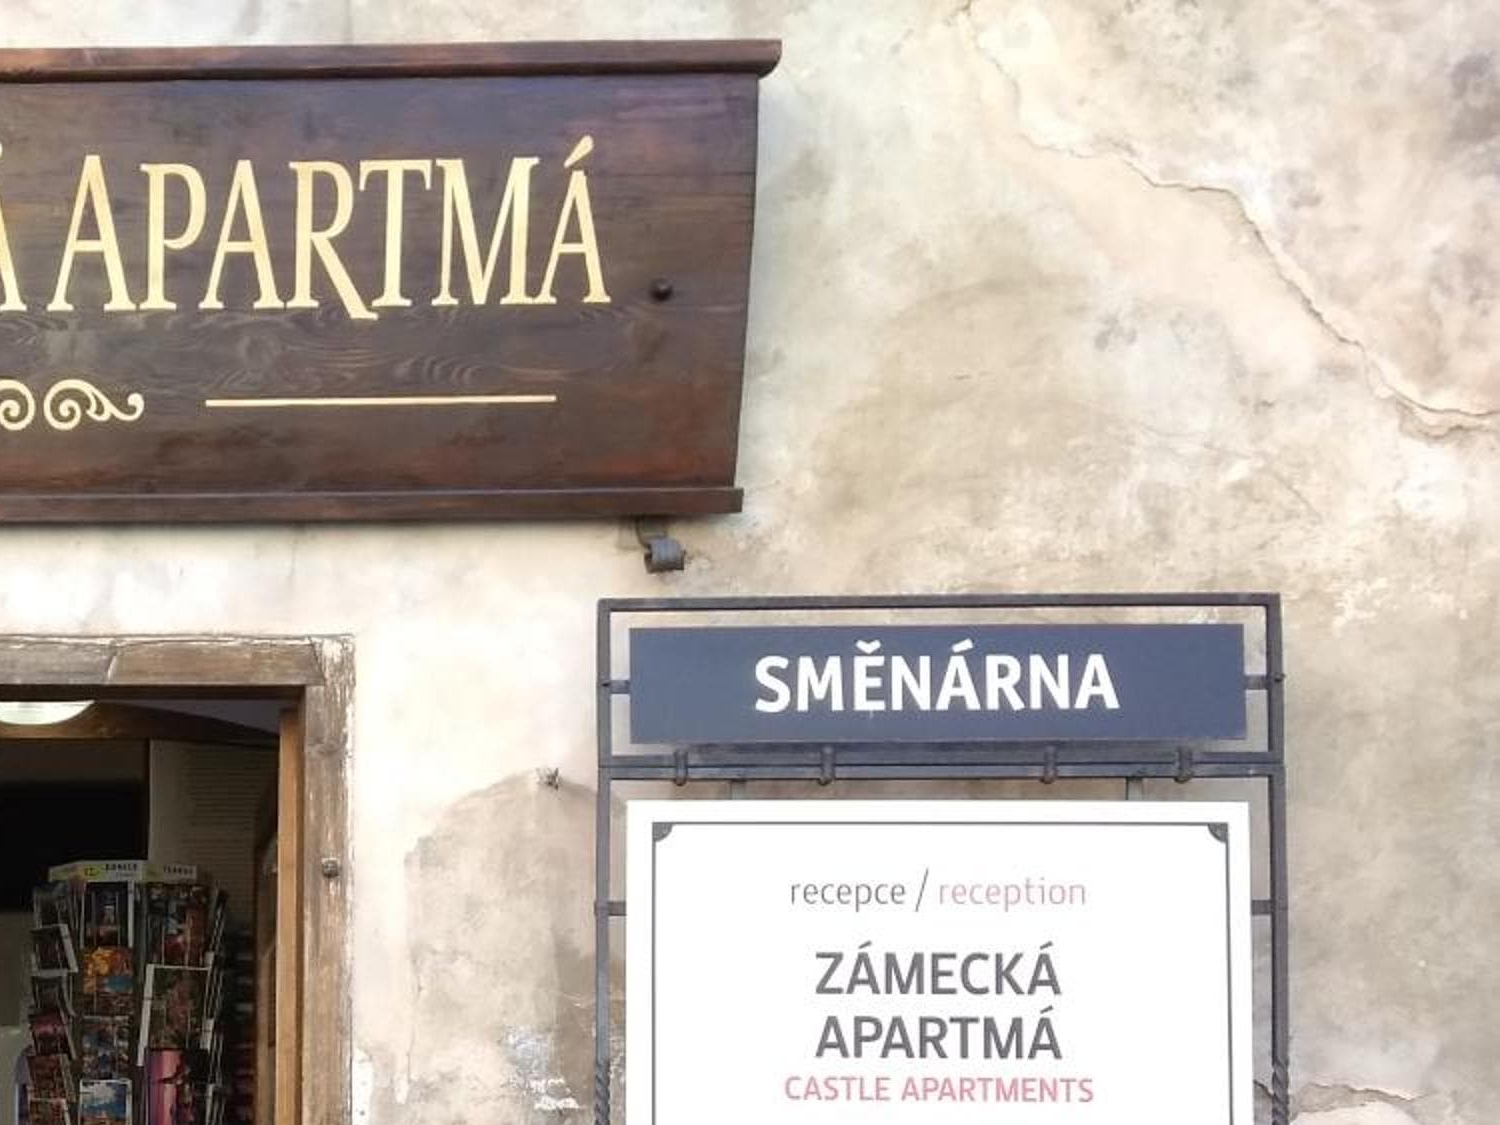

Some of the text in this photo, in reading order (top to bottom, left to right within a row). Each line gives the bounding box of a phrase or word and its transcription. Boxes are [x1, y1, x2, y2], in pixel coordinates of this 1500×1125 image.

[47, 135, 611, 320] APARTMÁ
[755, 639, 1119, 712] SMĚNÁRNA
[791, 884, 905, 912] recepce
[940, 877, 1086, 912] reception
[816, 941, 1062, 995] ZÁMECKÁ
[816, 1005, 1062, 1059] APARTMÁ
[785, 1076, 1093, 1102] CASTLE APARTMENTS
